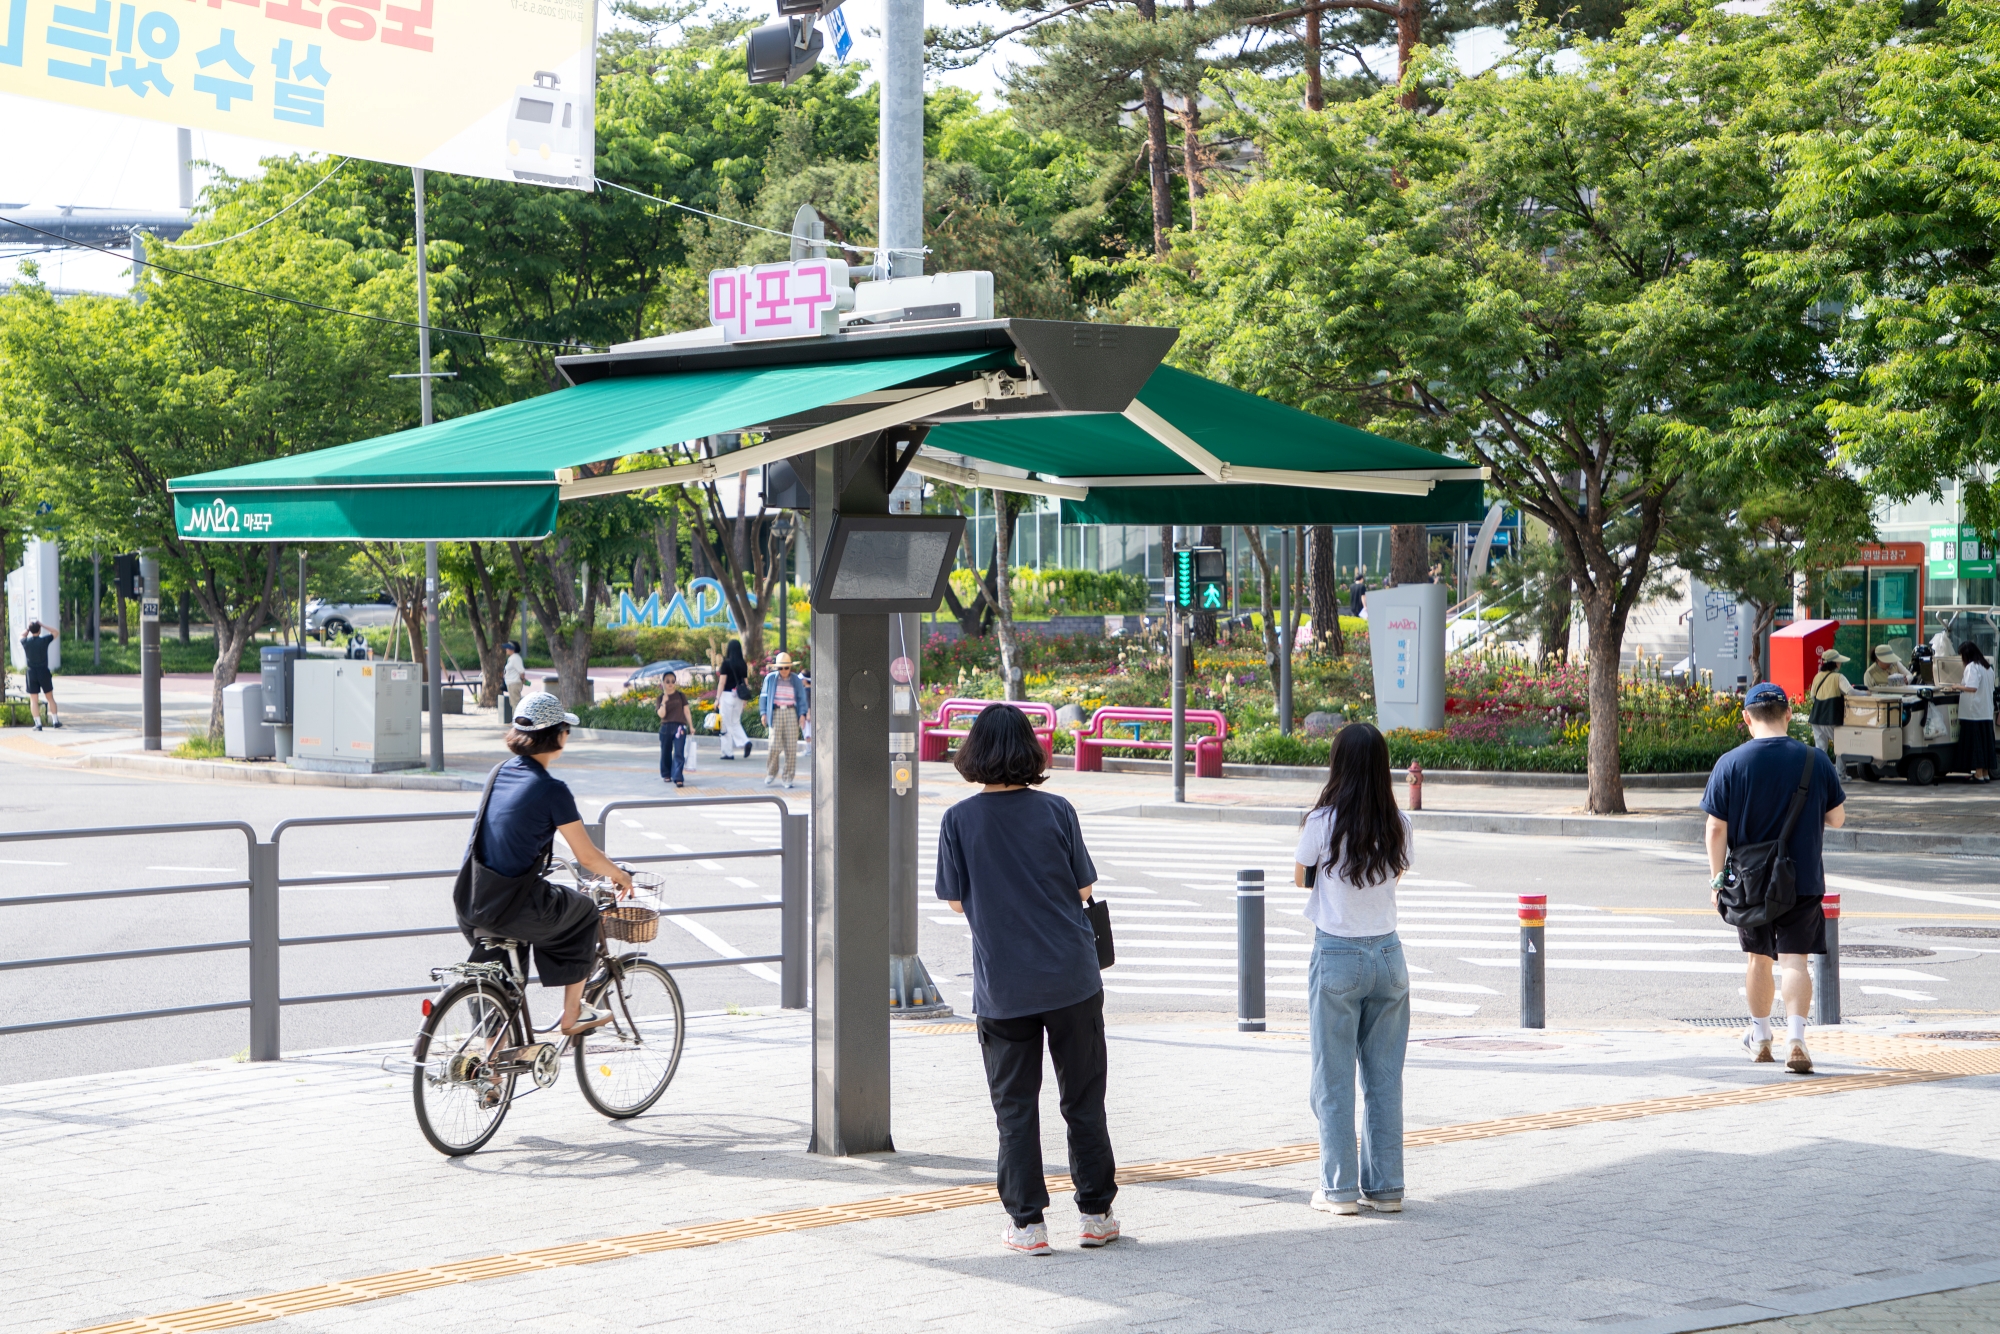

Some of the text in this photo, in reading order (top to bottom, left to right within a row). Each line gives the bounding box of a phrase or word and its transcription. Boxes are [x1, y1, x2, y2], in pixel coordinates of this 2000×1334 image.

[714, 266, 832, 335] 마포구
[243, 513, 273, 532] 마포구
[144, 604, 156, 612] 212
[1397, 639, 1406, 689] 마포구청
